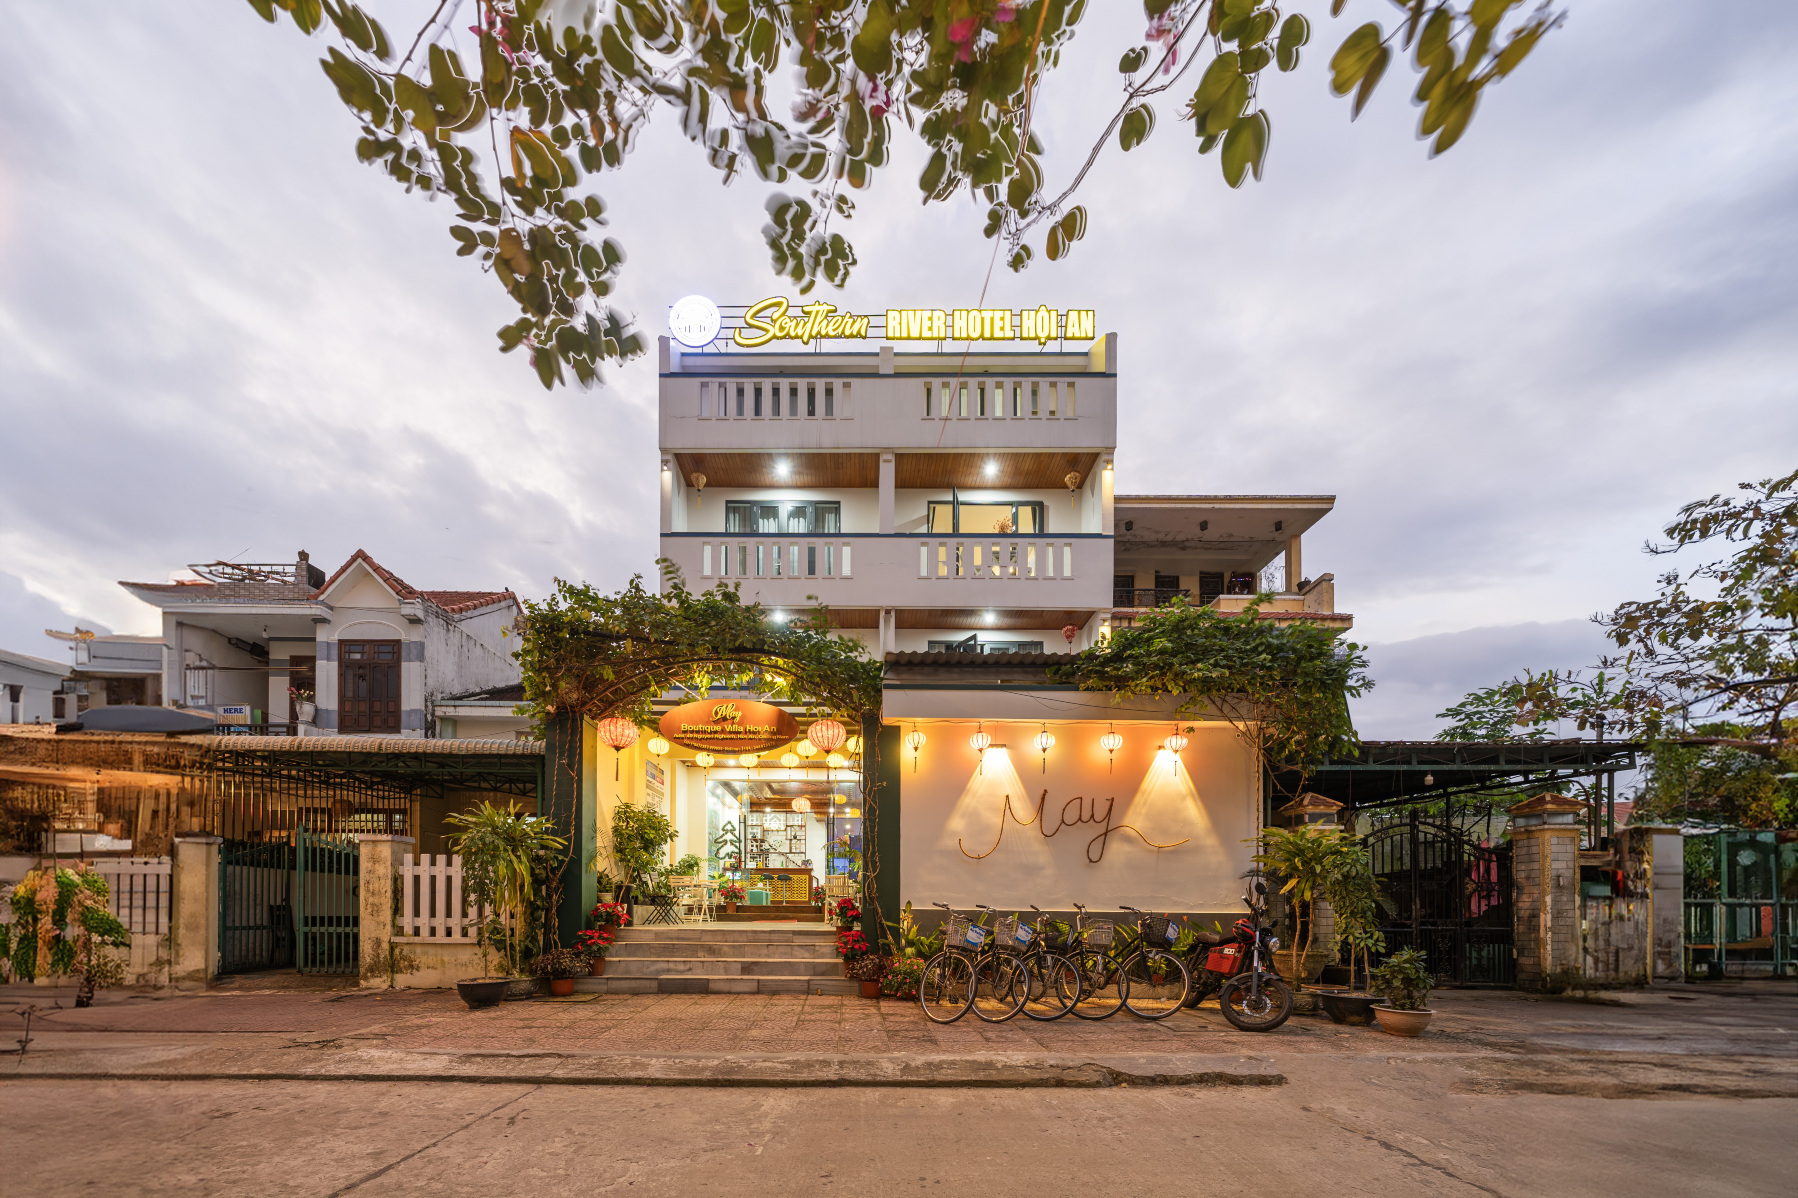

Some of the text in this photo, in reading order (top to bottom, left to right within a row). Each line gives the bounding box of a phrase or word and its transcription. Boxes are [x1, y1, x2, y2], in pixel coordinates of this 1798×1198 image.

[733, 296, 1095, 348] Southern RIVER HOTEL HỘI AN
[681, 723, 777, 733] Boutique Villa Hoi An
[710, 702, 742, 723] May
[958, 789, 1191, 863] May
